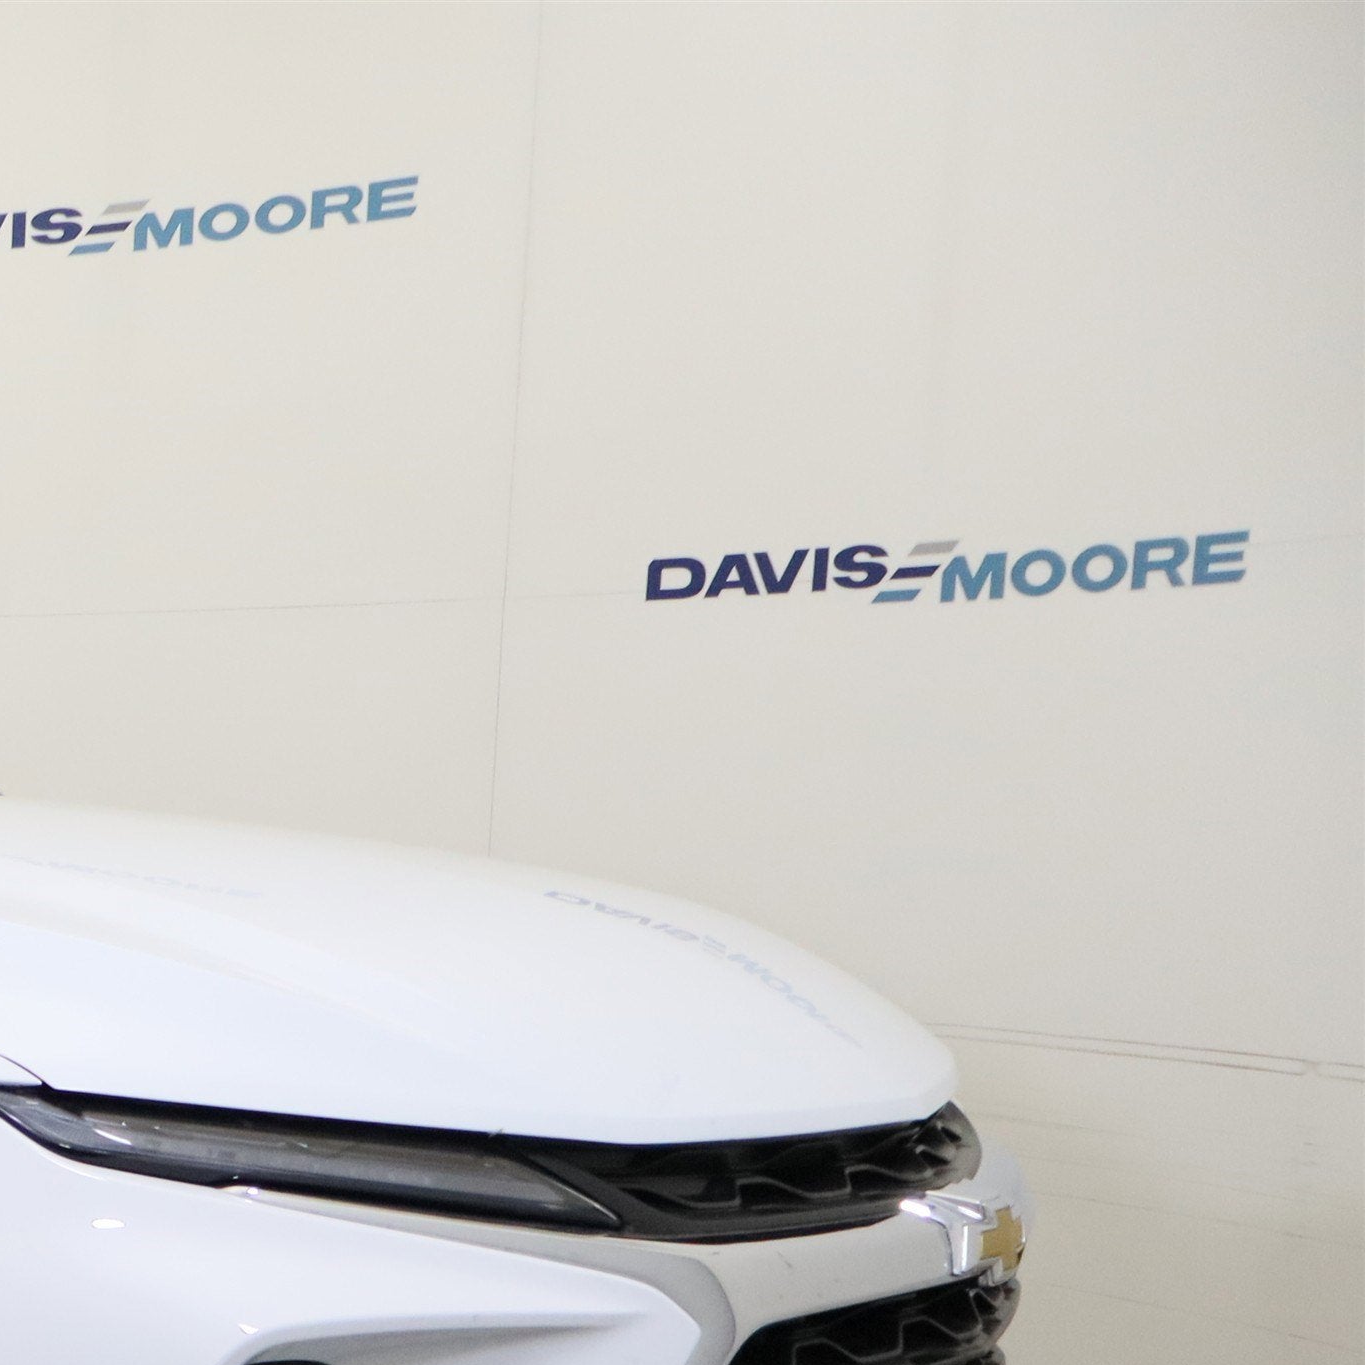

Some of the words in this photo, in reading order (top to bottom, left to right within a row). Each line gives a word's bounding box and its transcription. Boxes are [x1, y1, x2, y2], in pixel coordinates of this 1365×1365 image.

[133, 175, 420, 252] MOORE
[645, 544, 889, 602] DAVIS
[939, 529, 1251, 603] MOORE
